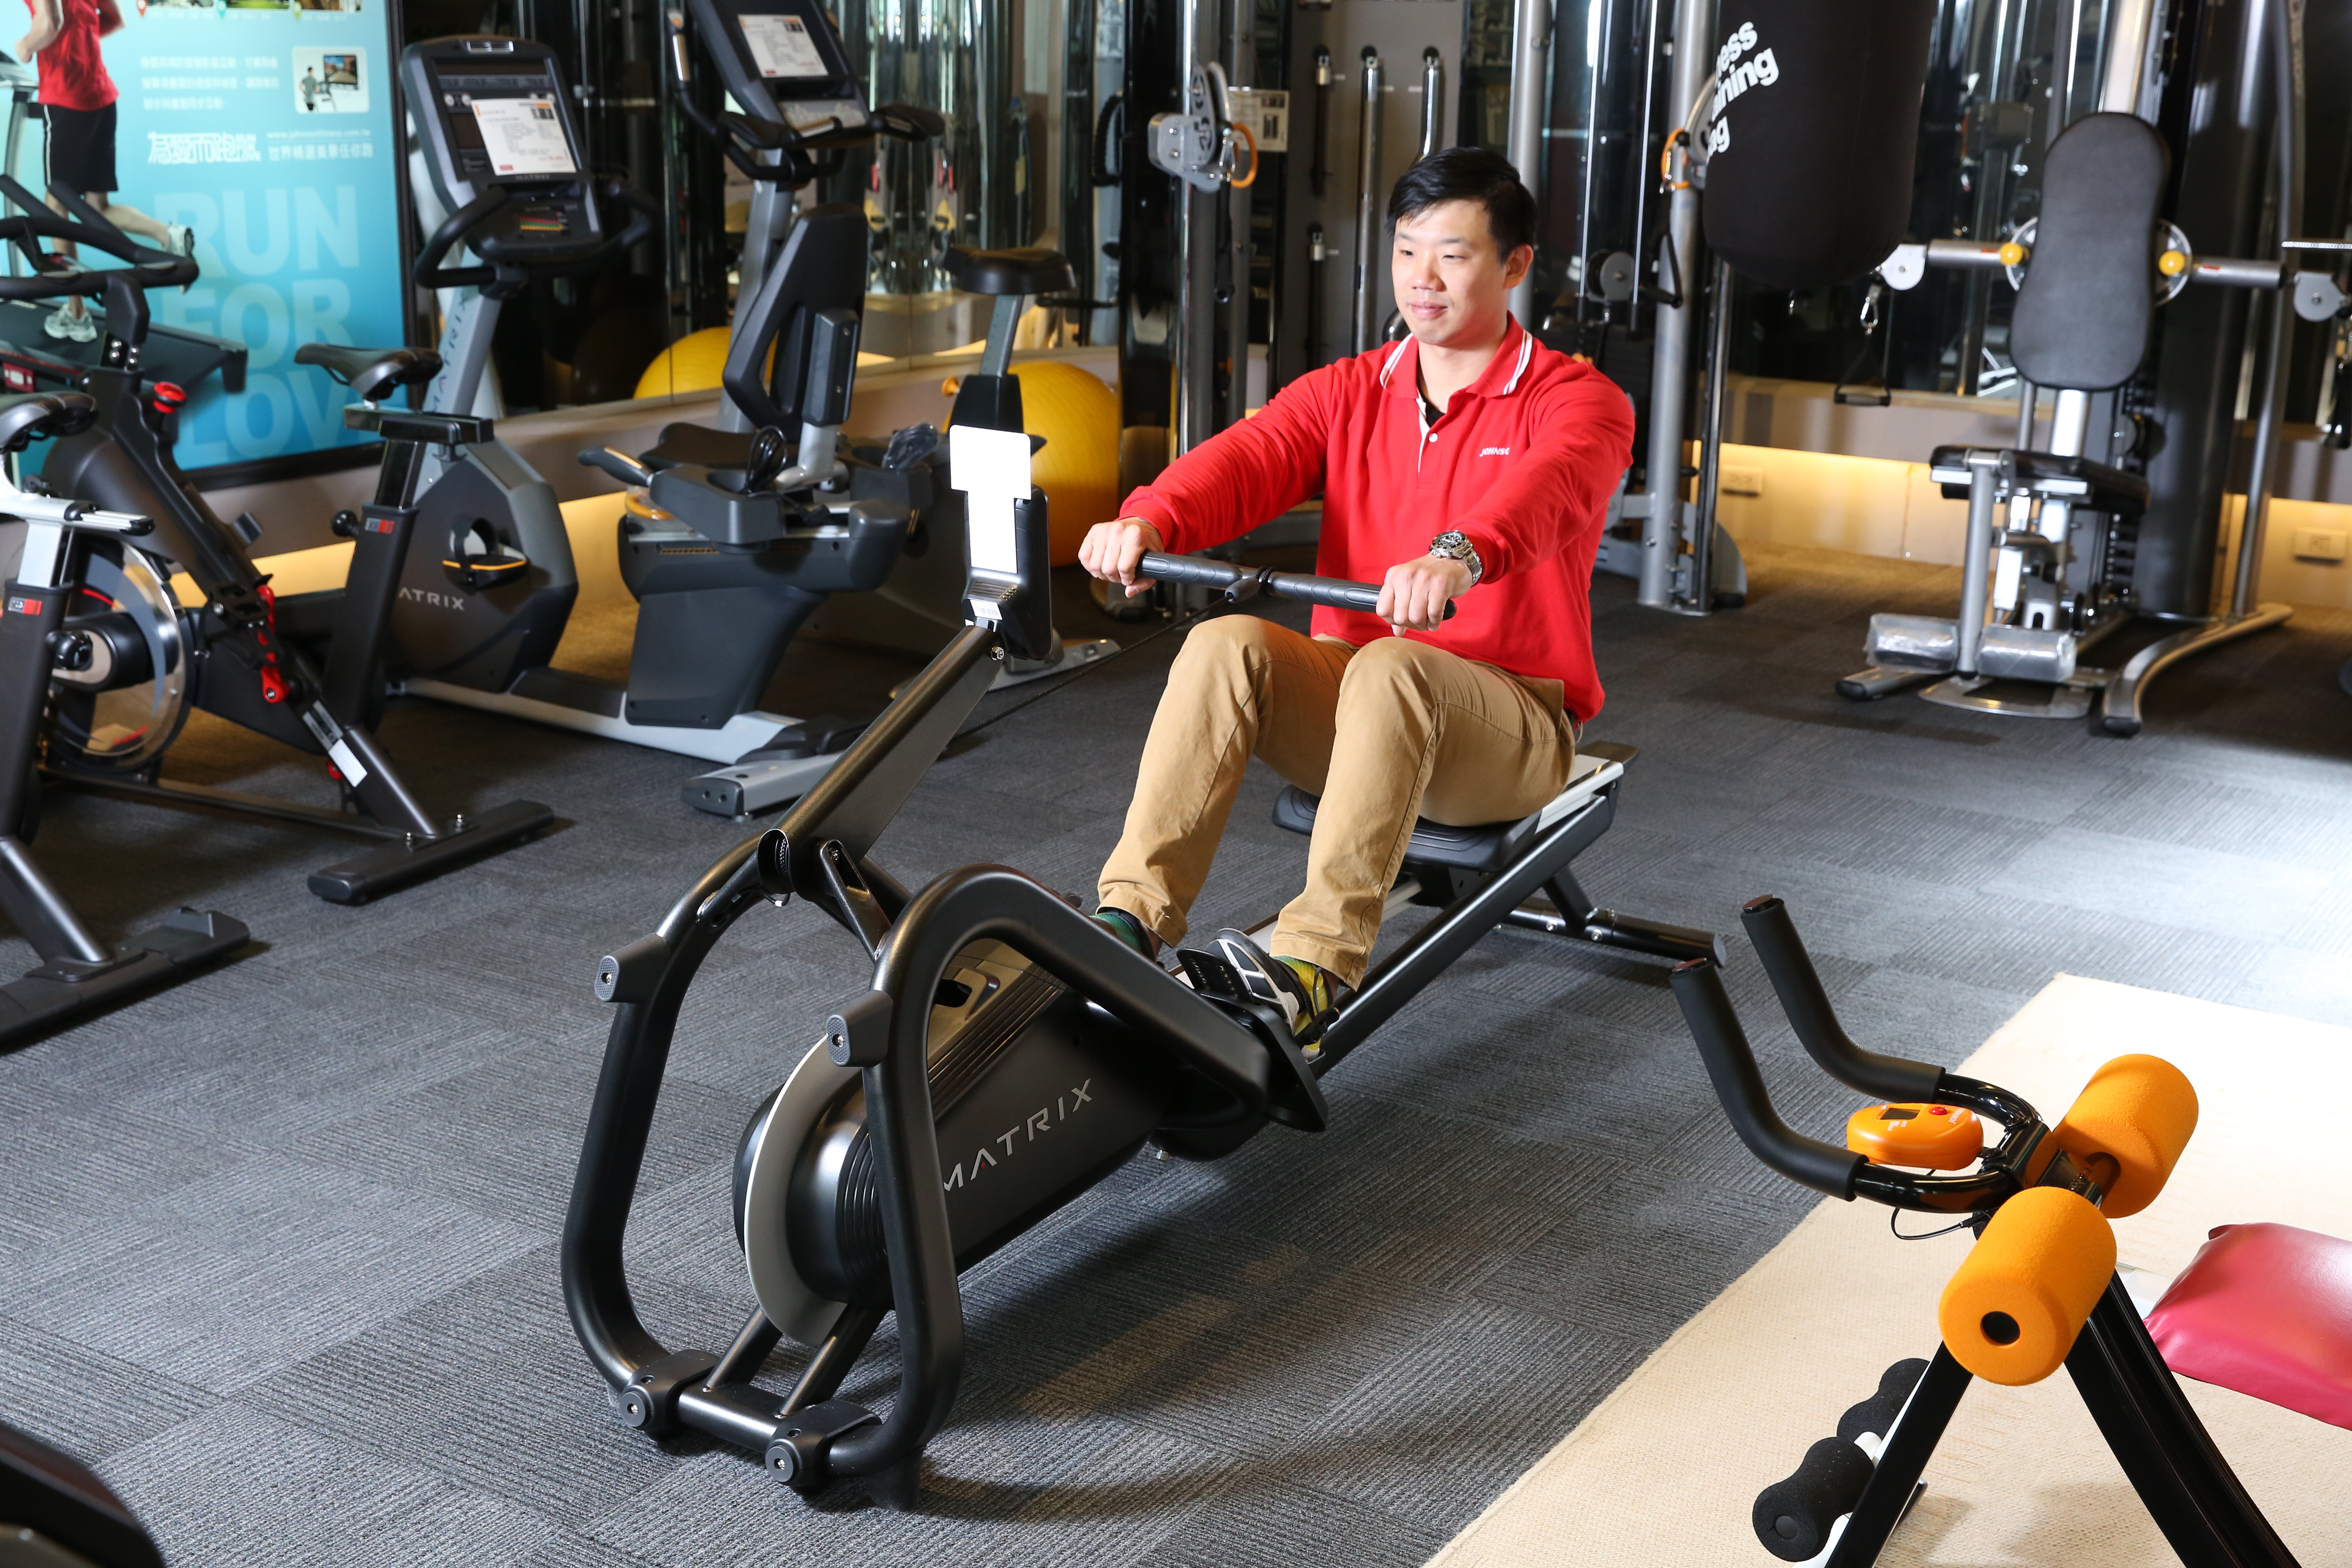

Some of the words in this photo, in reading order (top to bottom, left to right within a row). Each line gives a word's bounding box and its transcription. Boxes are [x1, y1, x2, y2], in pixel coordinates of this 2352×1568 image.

[1706, 116, 1731, 165] ag
[154, 185, 360, 278] RUN
[161, 278, 354, 369] FOR
[175, 370, 386, 462] LOV
[1479, 447, 1510, 457] JOHNSO
[398, 587, 465, 611] ATRIX
[943, 1078, 1092, 1192] MATRIX
